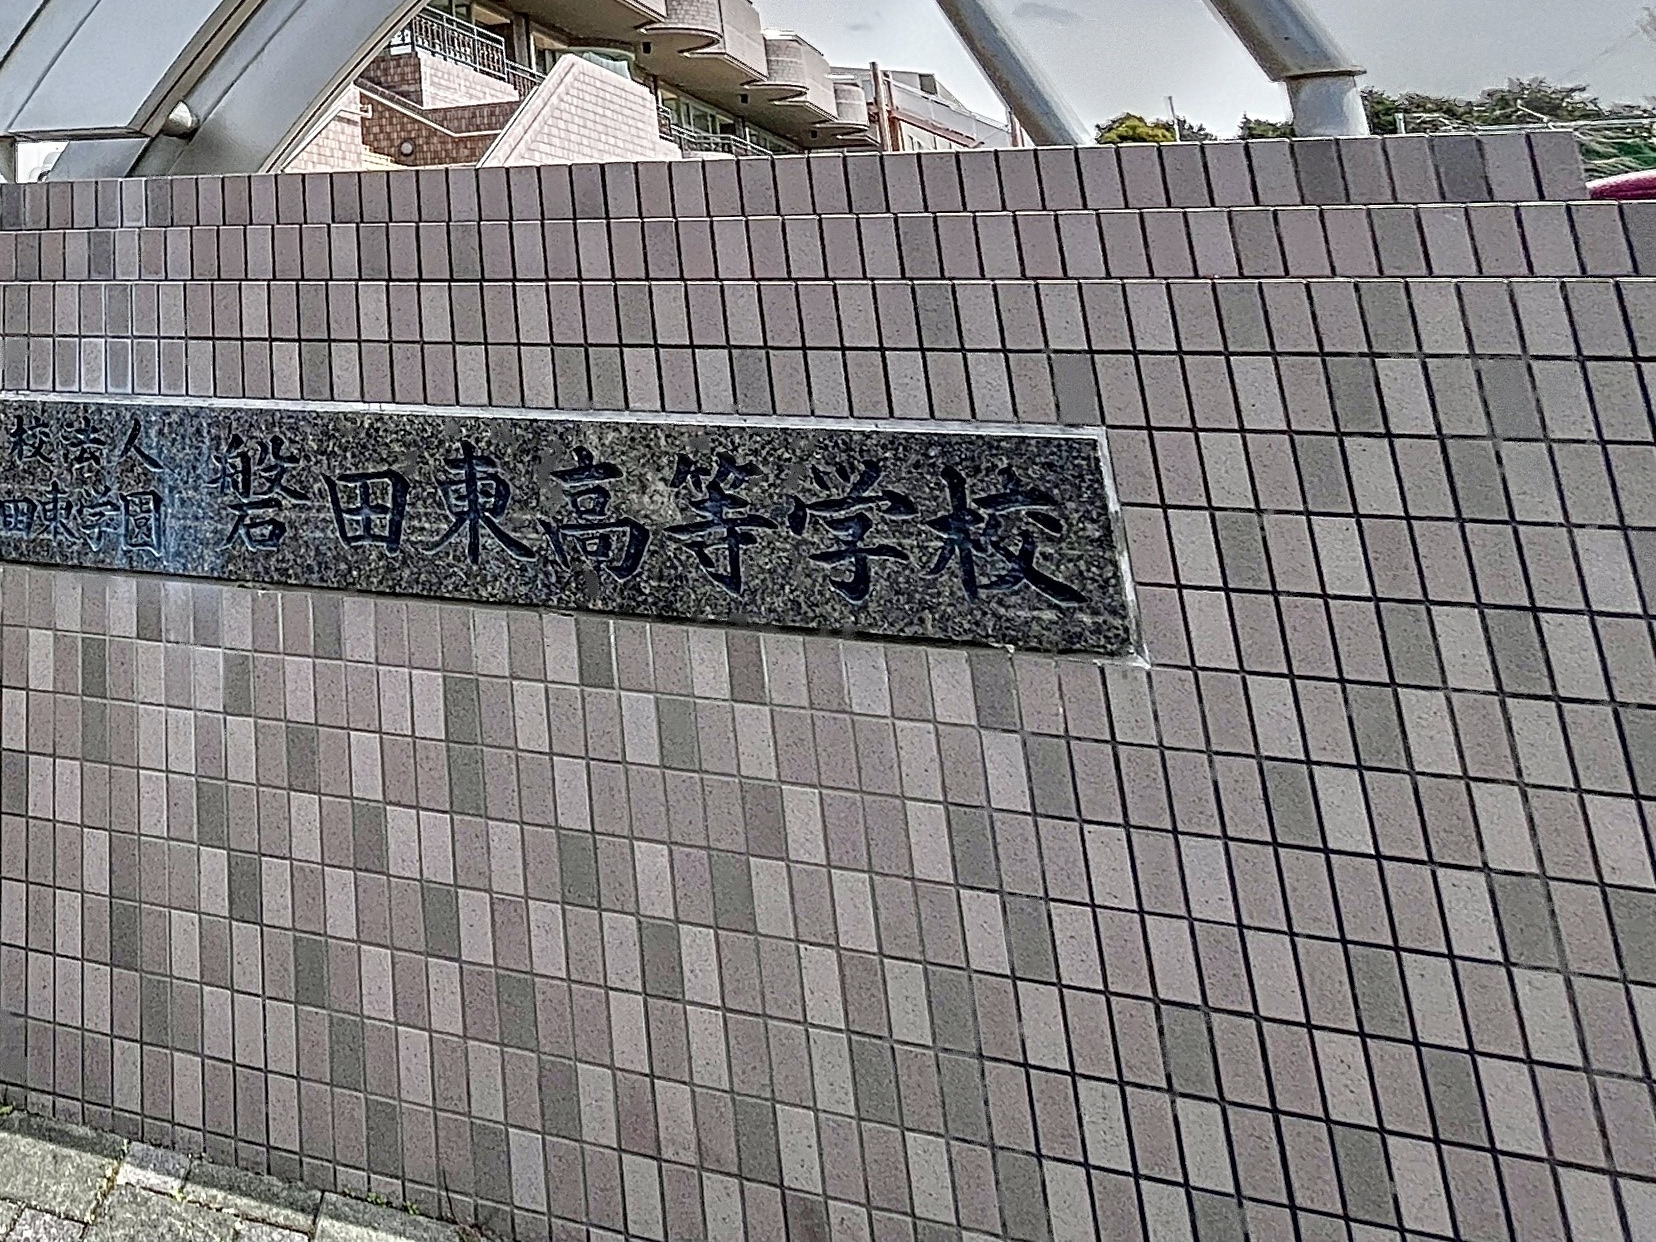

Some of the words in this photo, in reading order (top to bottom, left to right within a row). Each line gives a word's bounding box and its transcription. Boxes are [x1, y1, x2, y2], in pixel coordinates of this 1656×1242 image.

[207, 432, 1089, 606] 磐田東高等学校
